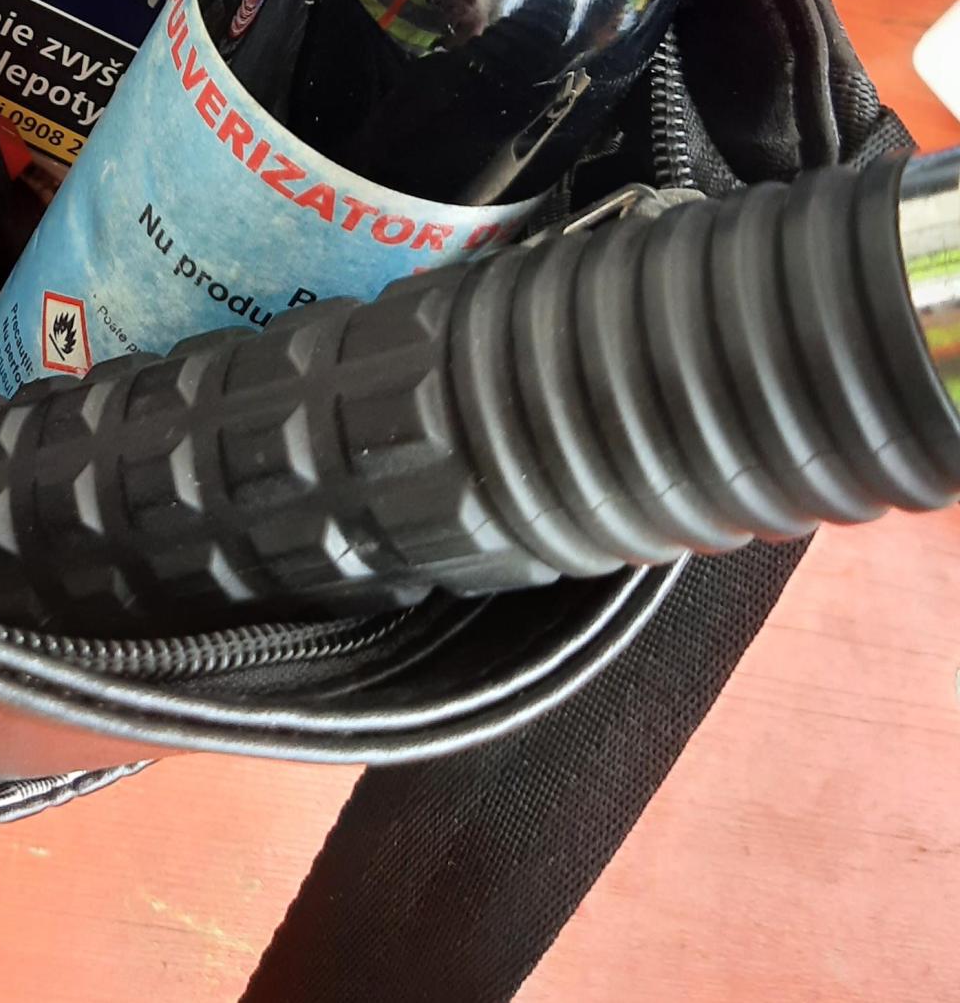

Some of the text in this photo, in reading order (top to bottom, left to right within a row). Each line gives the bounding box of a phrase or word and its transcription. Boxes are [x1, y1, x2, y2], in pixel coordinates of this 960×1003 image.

[39, 37, 124, 88] zvyš
[10, 108, 65, 147] 0908
[139, 203, 273, 328] Nu produ
